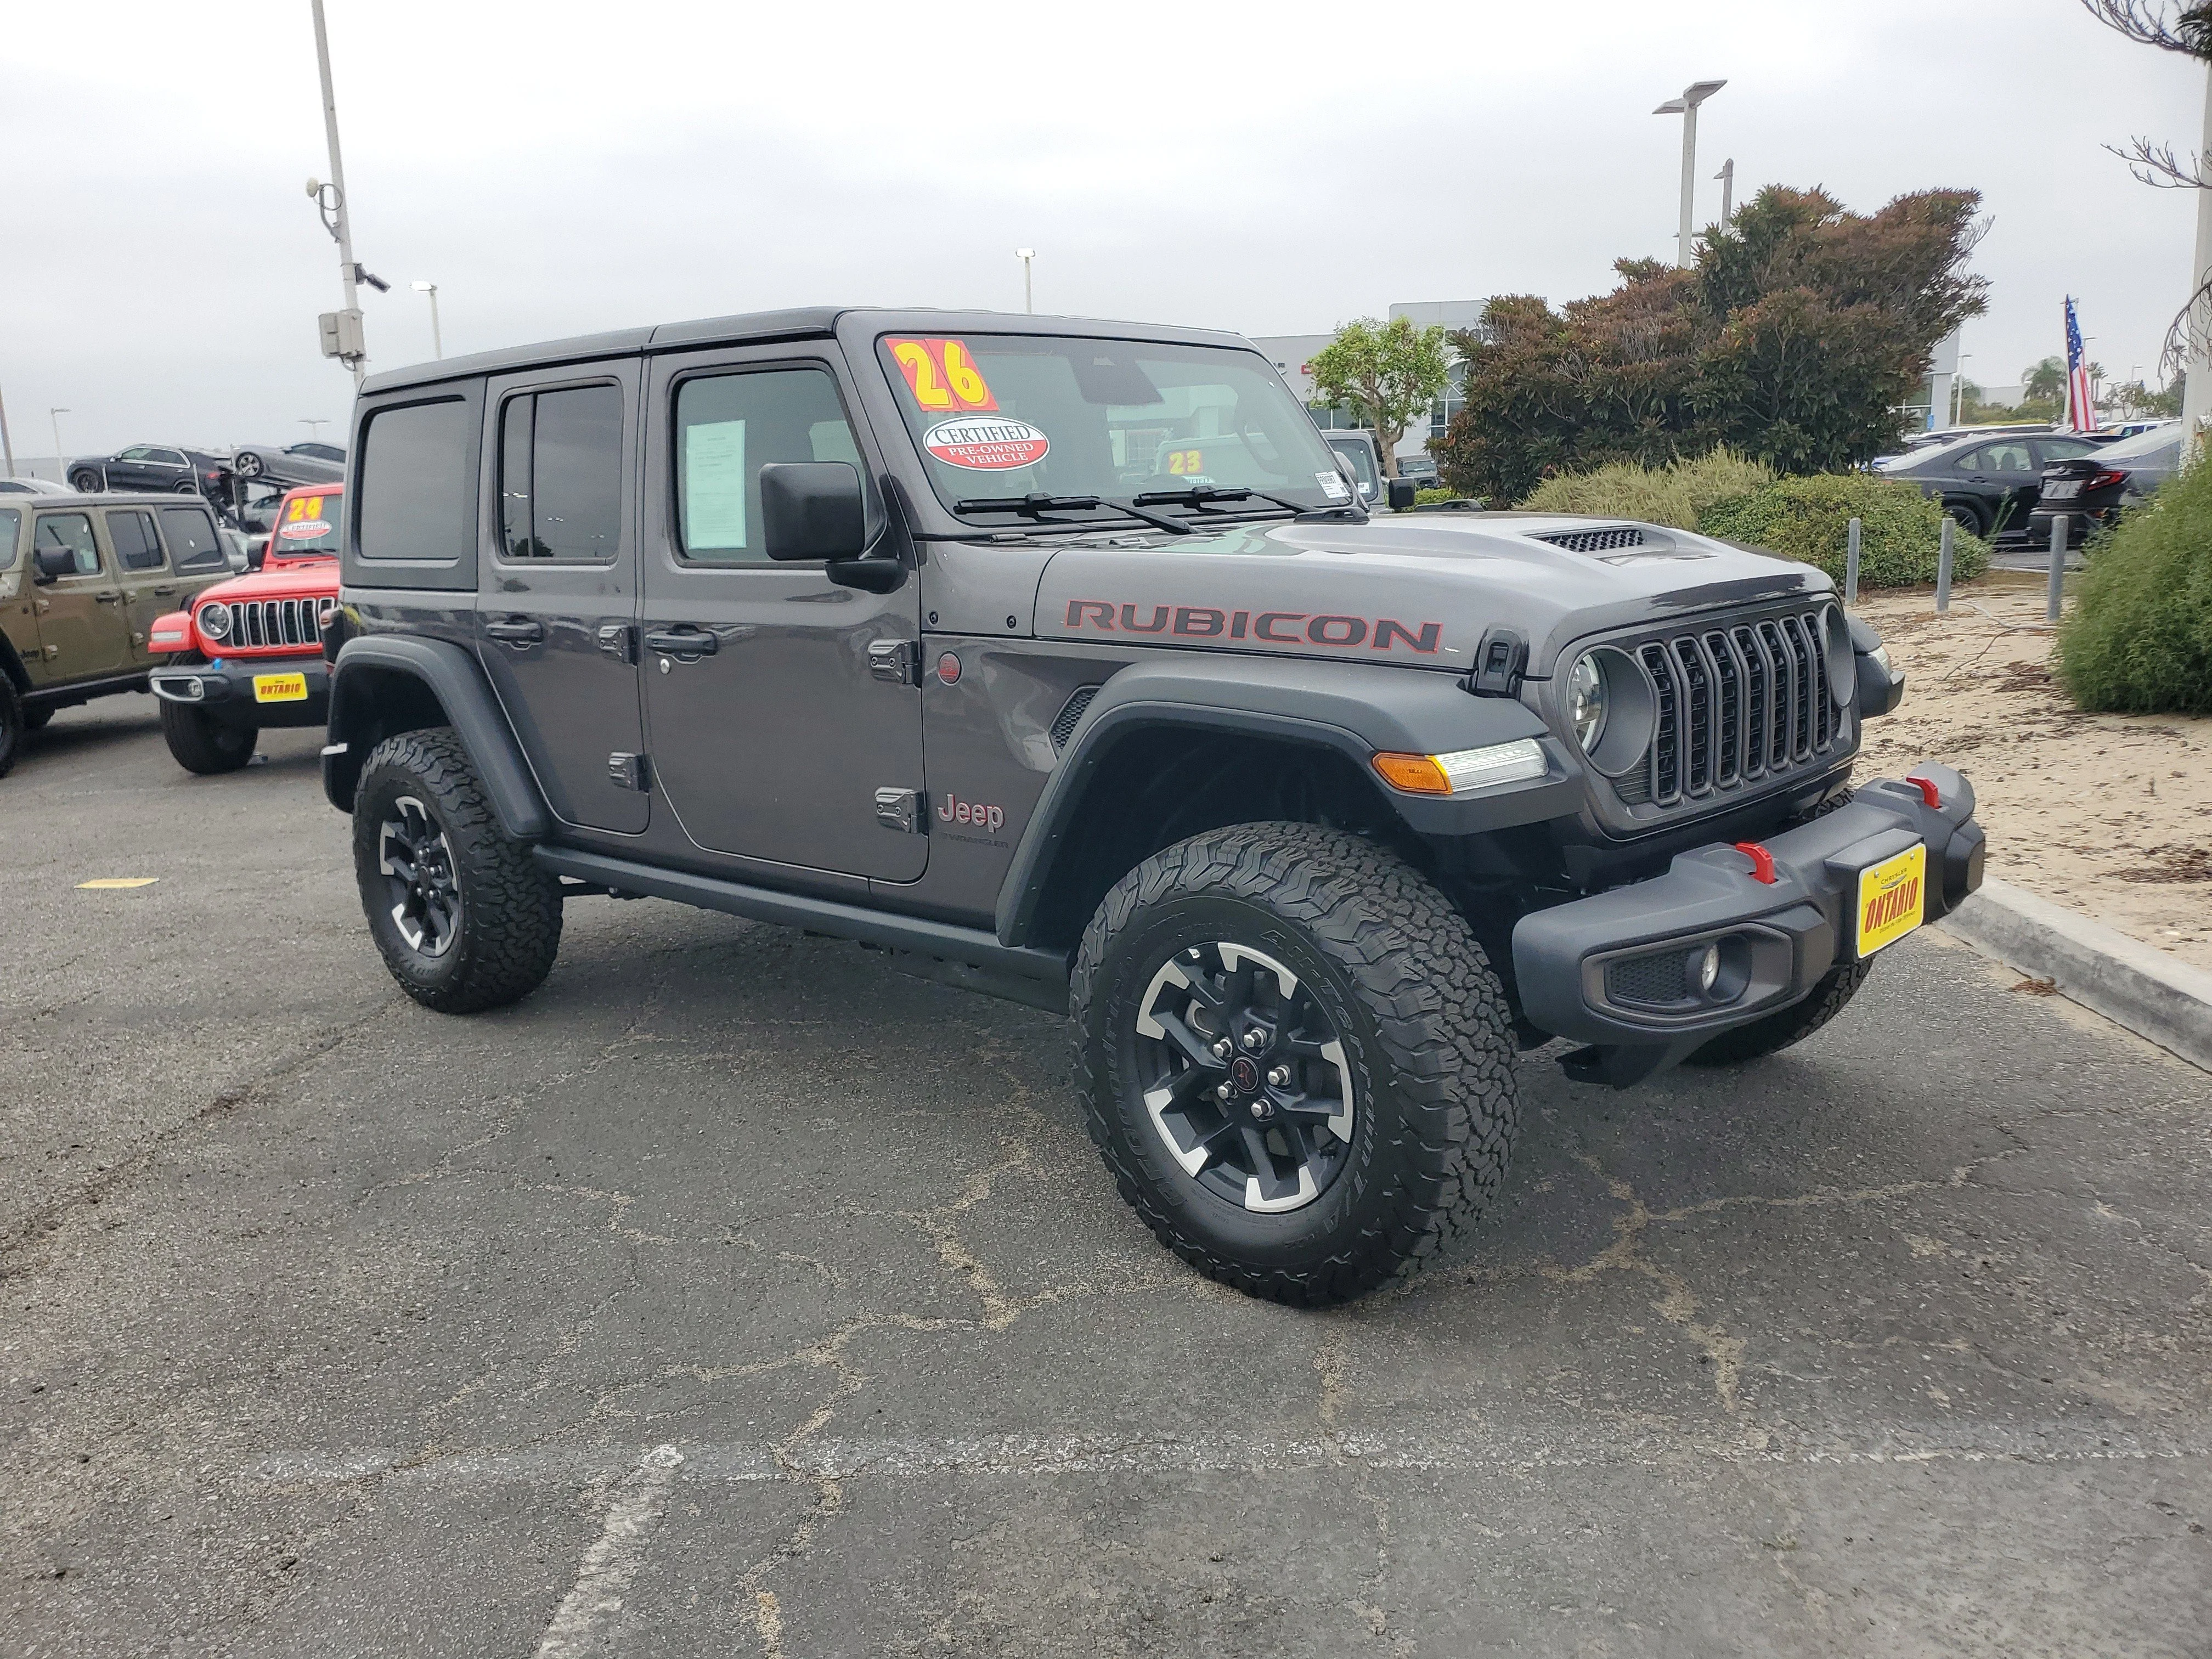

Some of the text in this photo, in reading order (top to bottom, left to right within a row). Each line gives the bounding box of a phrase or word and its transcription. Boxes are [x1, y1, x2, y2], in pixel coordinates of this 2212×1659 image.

[894, 342, 986, 406] 26
[934, 425, 1030, 444] CERTIFIED
[947, 443, 1034, 456] PRE-OWNED
[965, 452, 1029, 464] VEHICLE
[1169, 450, 1200, 475] 23
[288, 497, 321, 522] 24
[1065, 599, 1443, 654] RUBICON
[261, 682, 301, 695] ONTARIO
[937, 793, 1005, 833] Jeep
[1881, 867, 1908, 885] CHRYSLER
[1865, 877, 1918, 934] ONTARIO
